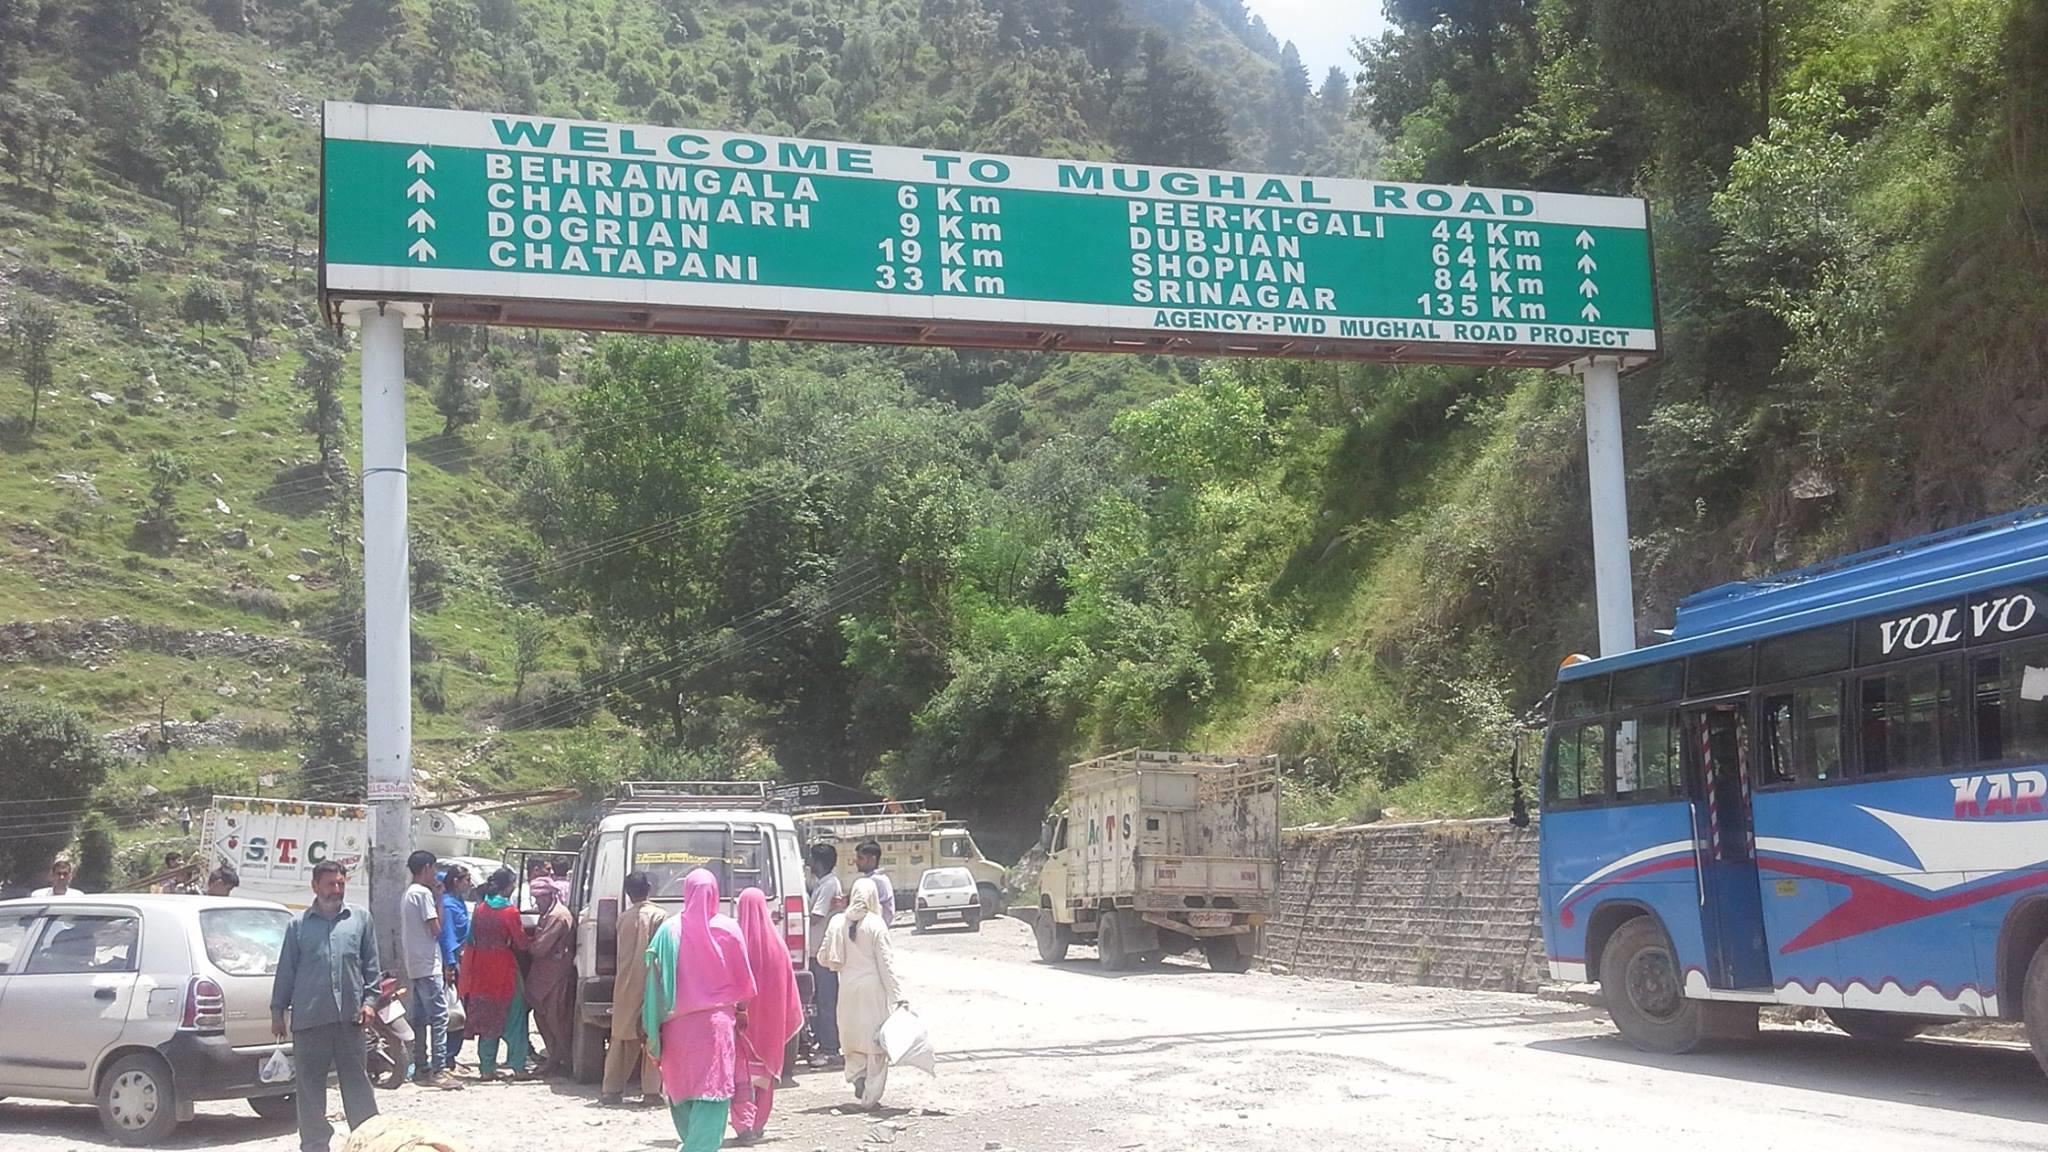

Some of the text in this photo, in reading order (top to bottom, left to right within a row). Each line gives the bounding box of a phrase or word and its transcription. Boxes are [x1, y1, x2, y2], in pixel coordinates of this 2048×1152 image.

[486, 153, 1000, 214] BEHRAMGALA 6 Km
[492, 119, 1534, 216] WELCOME TO MUGHAL ROAD
[487, 183, 1002, 241] CHANDIMARH 9 Km
[1128, 201, 1540, 247] PEER-KI-GALI 44 Km
[488, 211, 1003, 267] DOGRIAN 19 Km
[1130, 227, 1542, 271] DUBJIAN 64 Km
[489, 241, 1005, 294] CHATAPANI 33 Km
[1131, 253, 1544, 295] SHOPIAN 84 Km
[1133, 279, 1546, 319] SRINAGAR 135 Km
[1340, 320, 1441, 339] MUGHAL
[1454, 324, 1517, 342] ROAD
[1530, 327, 1629, 346] PROJECT
[1880, 594, 2036, 654] VOLVO
